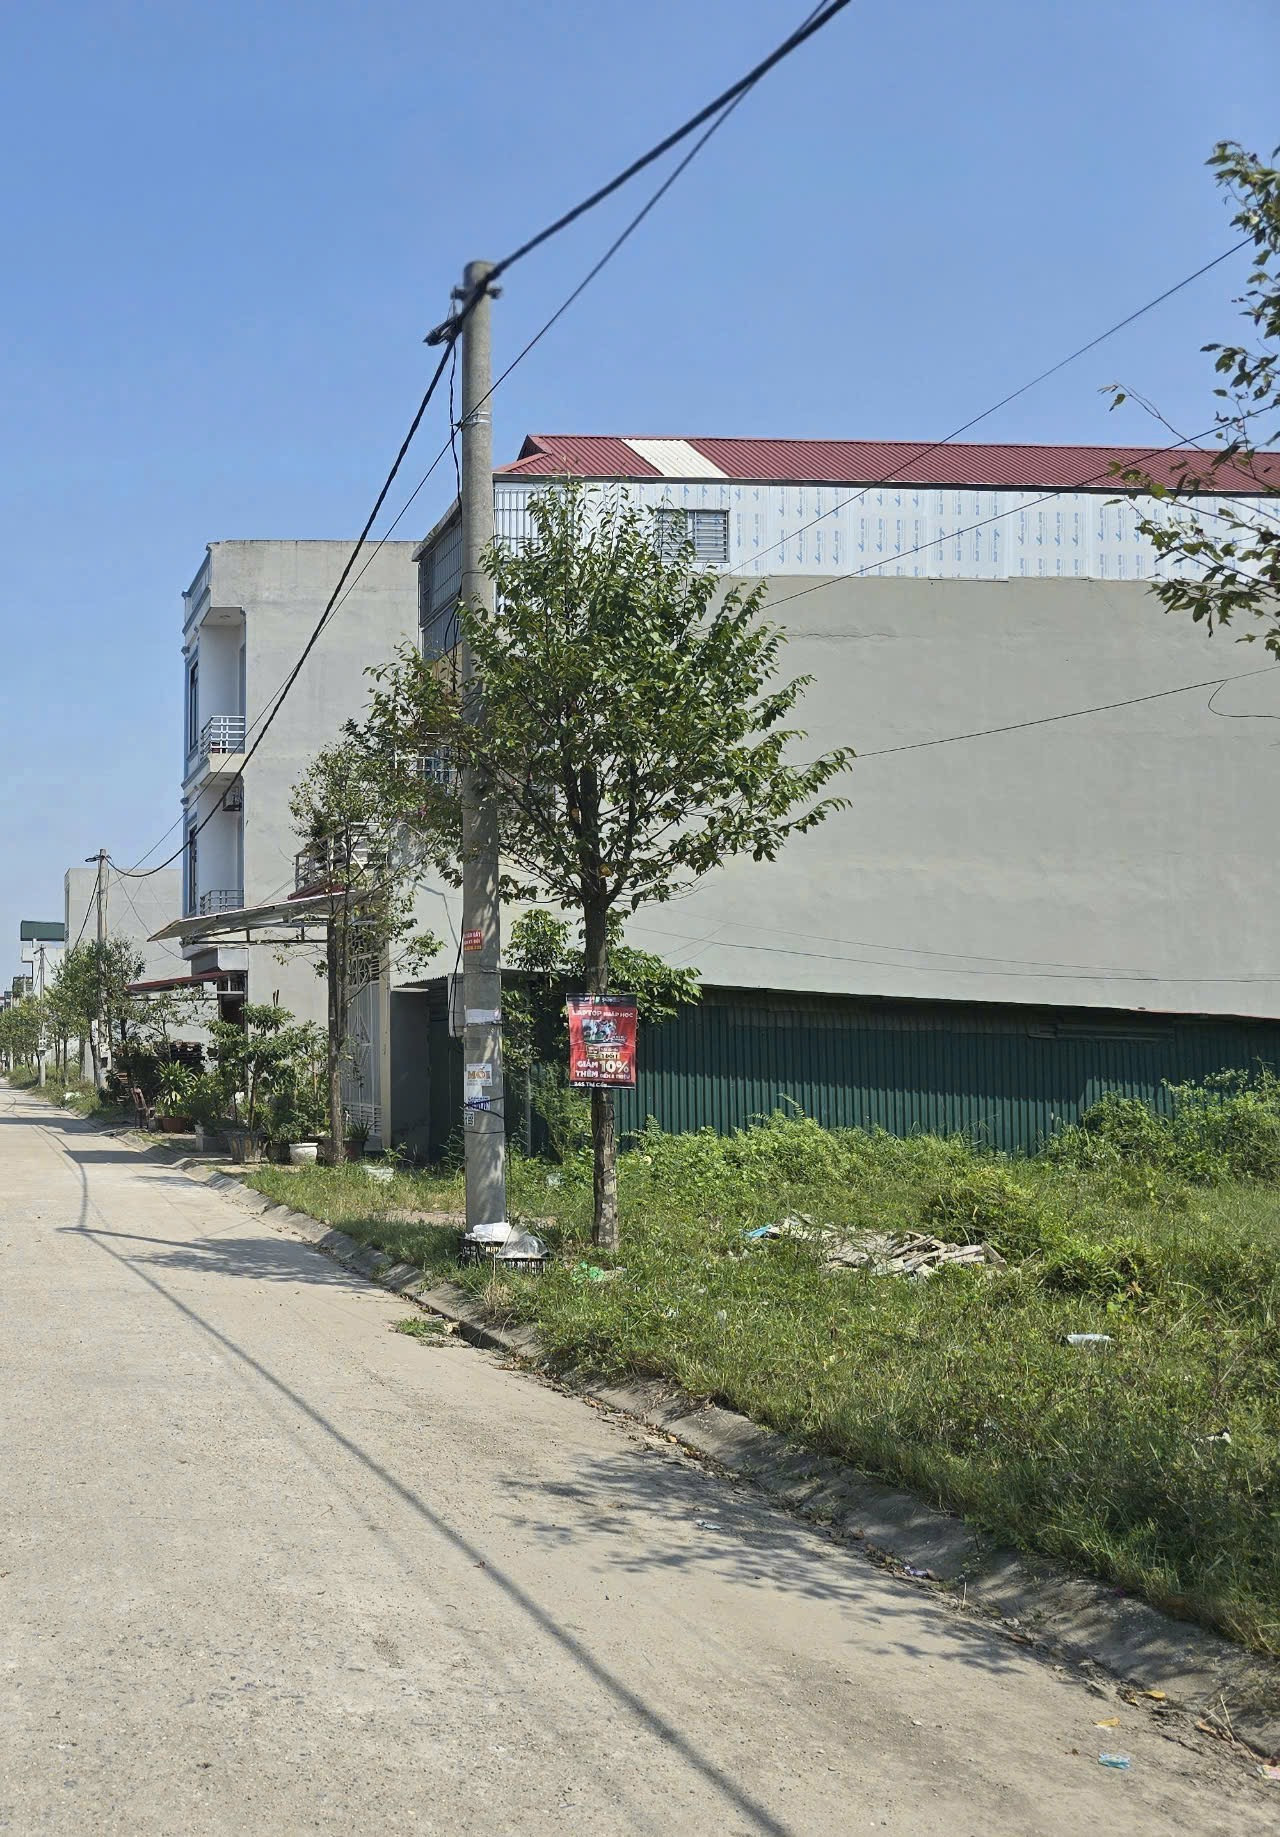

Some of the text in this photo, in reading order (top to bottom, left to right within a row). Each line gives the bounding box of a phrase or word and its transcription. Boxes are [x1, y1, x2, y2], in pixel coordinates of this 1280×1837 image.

[577, 1059, 630, 1073] GIẢM 10%
[575, 1069, 599, 1078] THÊM
